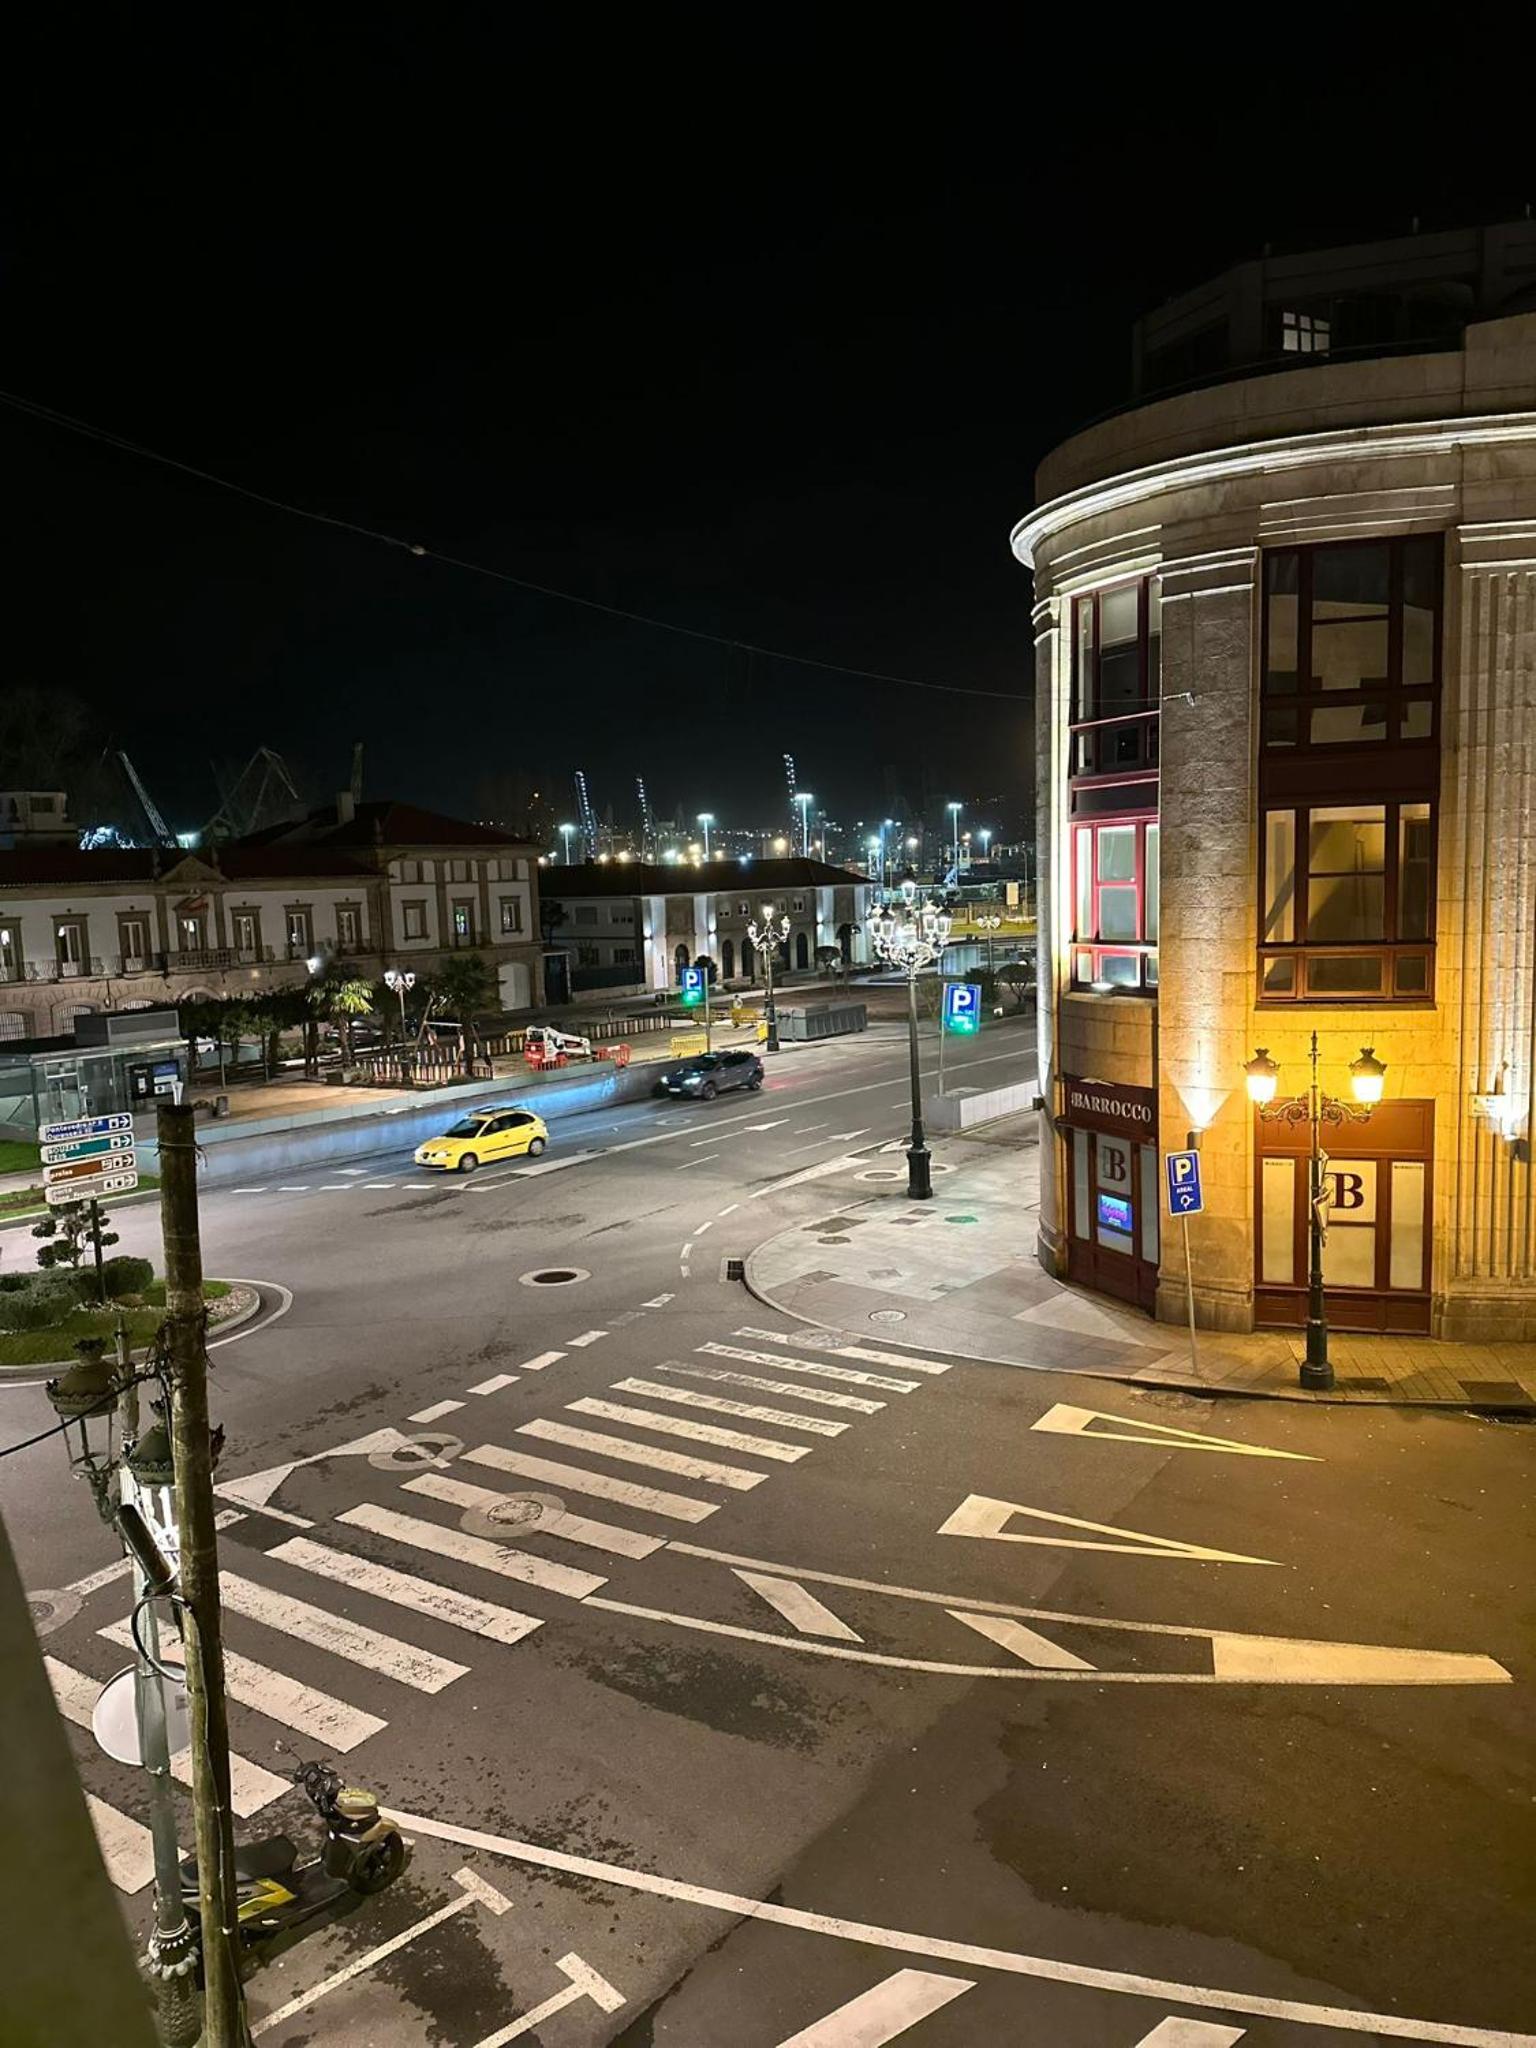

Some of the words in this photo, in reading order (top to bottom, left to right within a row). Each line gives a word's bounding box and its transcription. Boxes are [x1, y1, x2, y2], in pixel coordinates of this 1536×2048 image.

[686, 971, 698, 990] P
[953, 990, 971, 1014] P
[1071, 1092, 1152, 1123] BARROCCO
[1102, 1145, 1126, 1182] B
[1175, 1158, 1191, 1182] P
[1324, 1172, 1365, 1209] B
